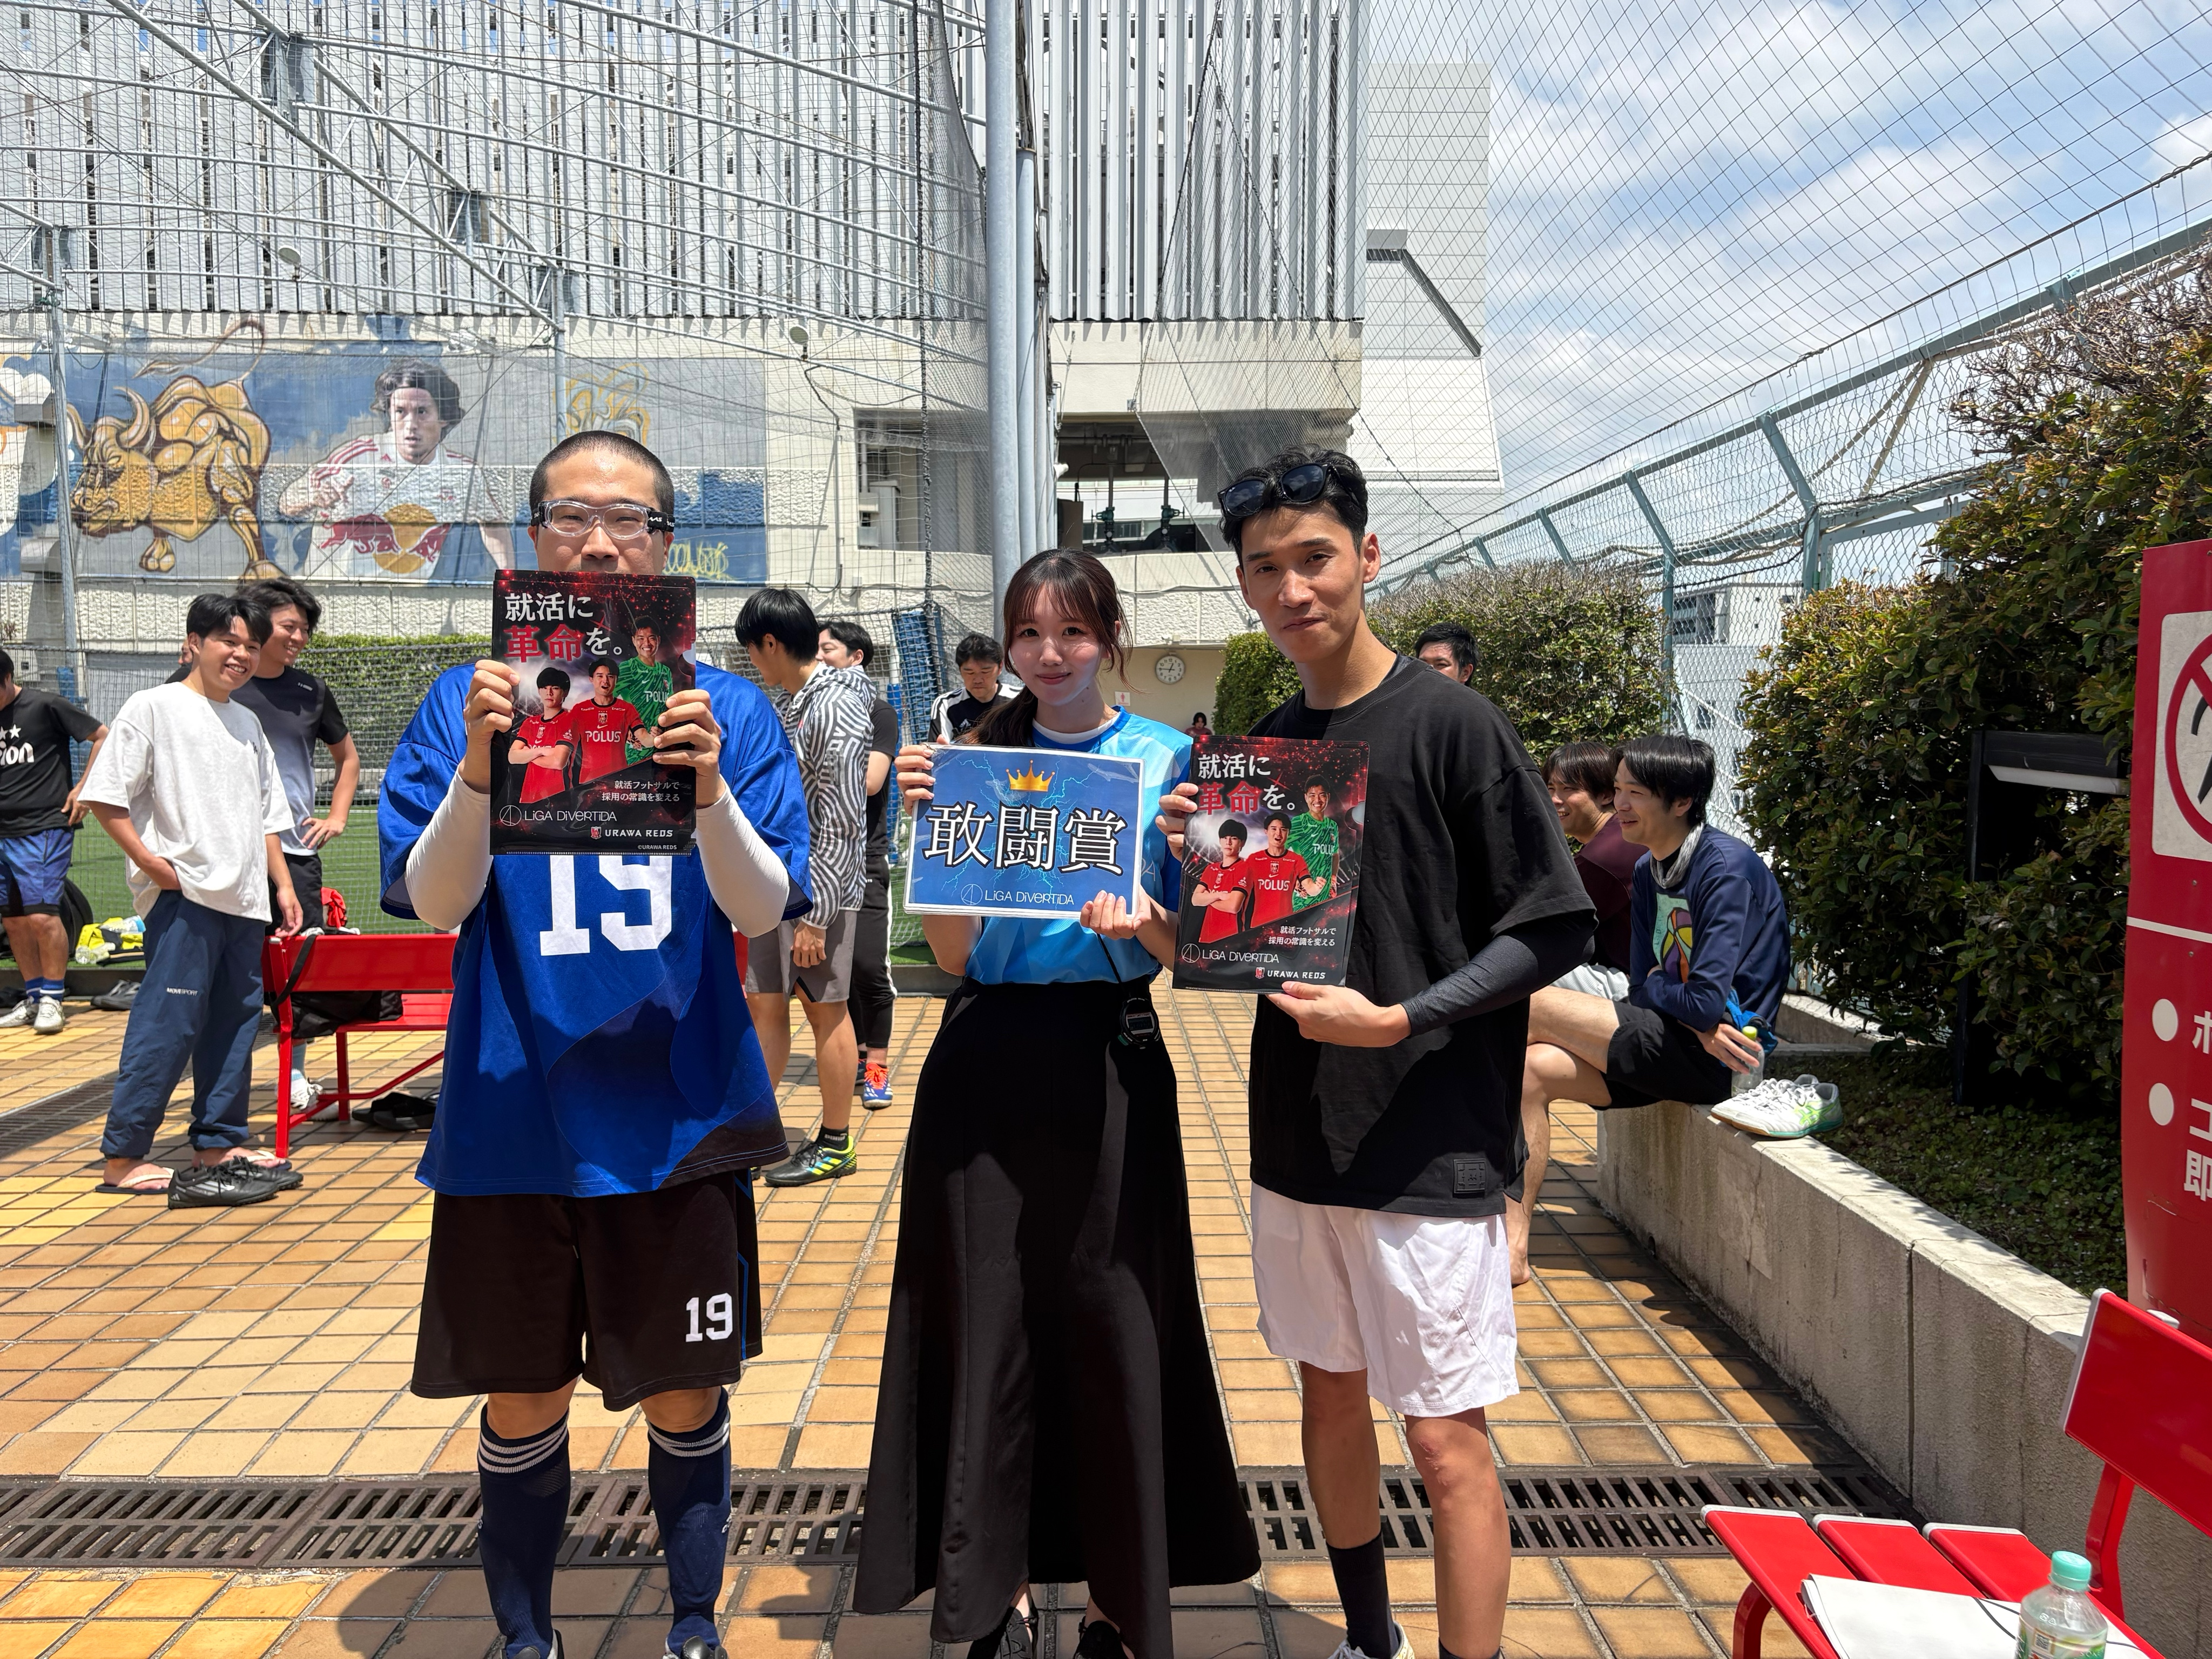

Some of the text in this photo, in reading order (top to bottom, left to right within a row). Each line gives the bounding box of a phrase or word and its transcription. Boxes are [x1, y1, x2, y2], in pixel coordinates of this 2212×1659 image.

[504, 592, 594, 622] 就活に
[503, 624, 622, 663] 革命を。
[585, 731, 622, 743] POLUS
[1198, 753, 1271, 779] 就活に
[615, 780, 680, 790] 就活フットサルで
[602, 792, 680, 801] 採用の常識を変える
[1197, 780, 1295, 815] 革命を。
[923, 801, 1127, 876] 敢闘賞
[1258, 879, 1290, 891] POLUS
[540, 855, 672, 956] 19
[1280, 926, 1337, 935] 就活フットサルで
[1268, 936, 1336, 946] 採用の常識を変える
[1267, 970, 1299, 979] URAWA
[685, 1292, 733, 1343] 19
